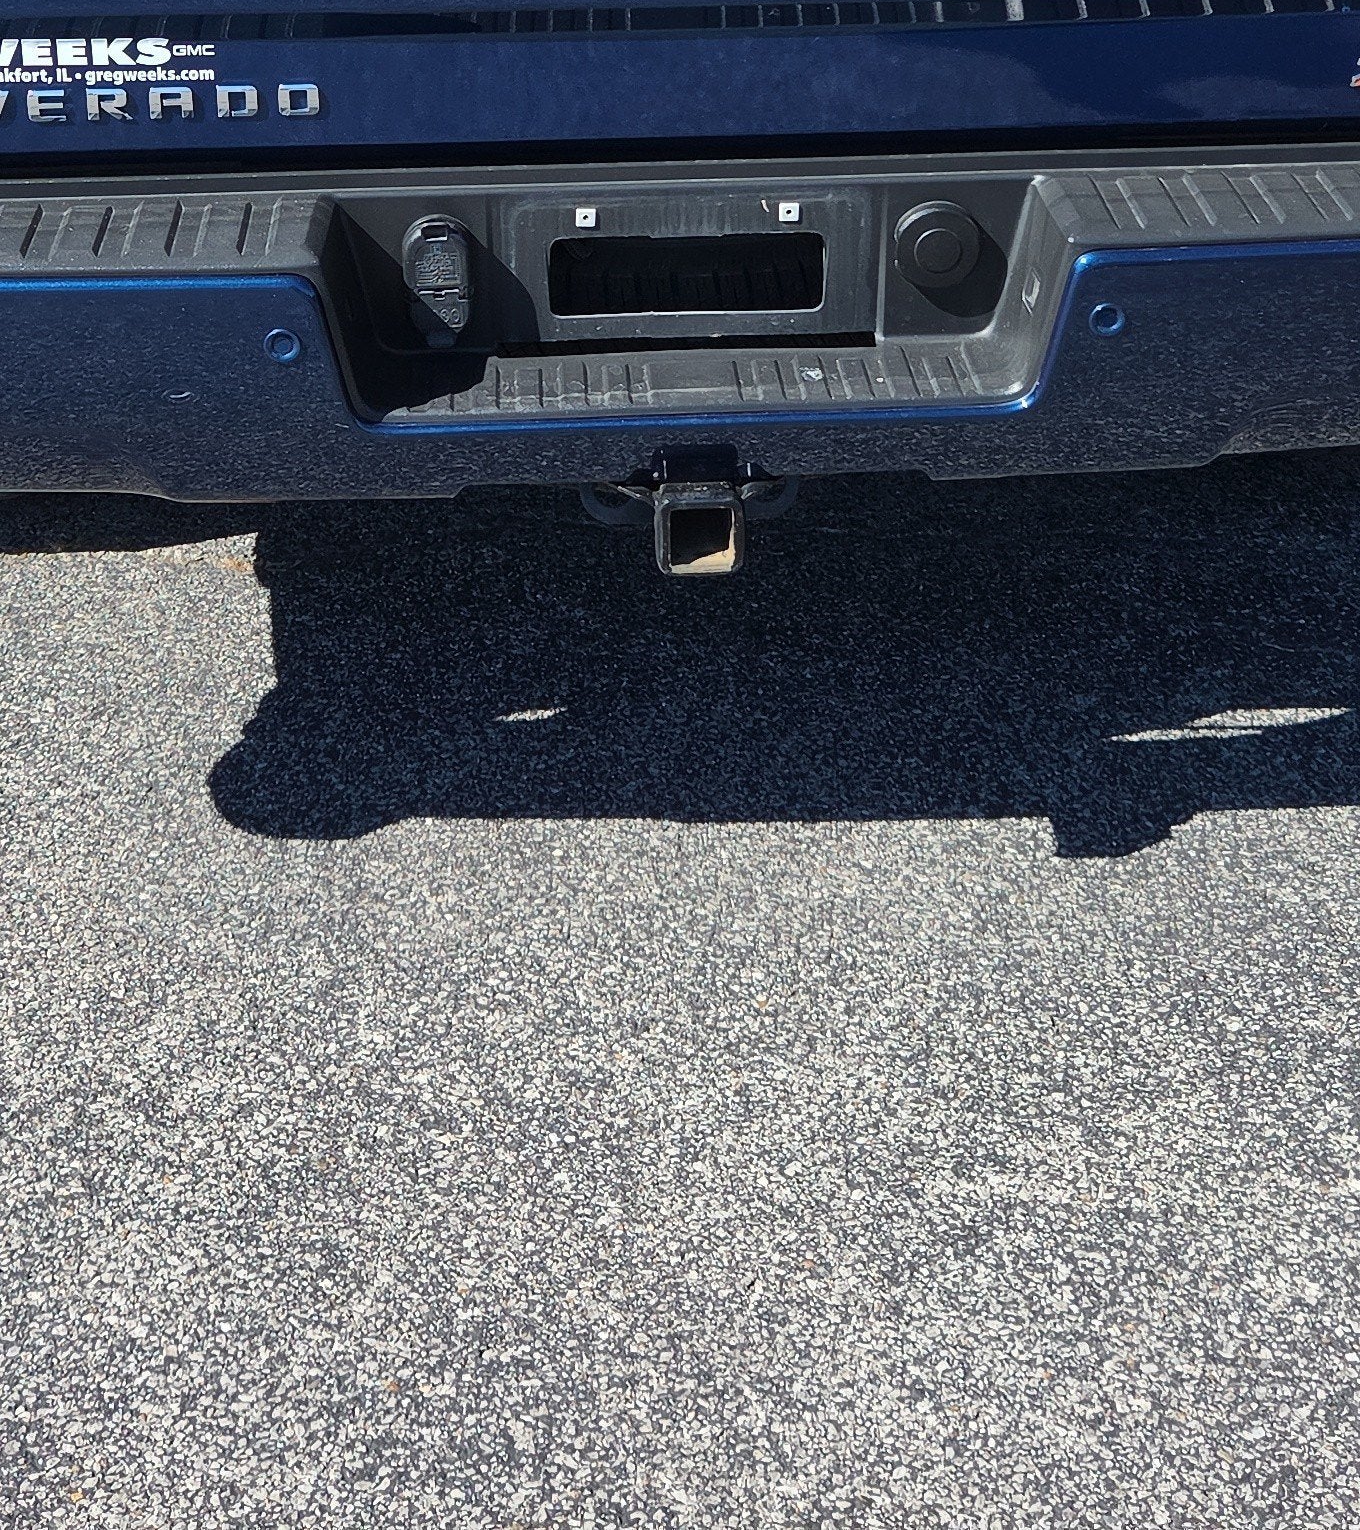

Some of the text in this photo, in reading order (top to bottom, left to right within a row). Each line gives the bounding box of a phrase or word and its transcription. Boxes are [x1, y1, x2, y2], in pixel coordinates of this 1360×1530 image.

[172, 44, 215, 56] GMC
[56, 68, 73, 83] IL
[84, 67, 215, 86] gregweeks.com
